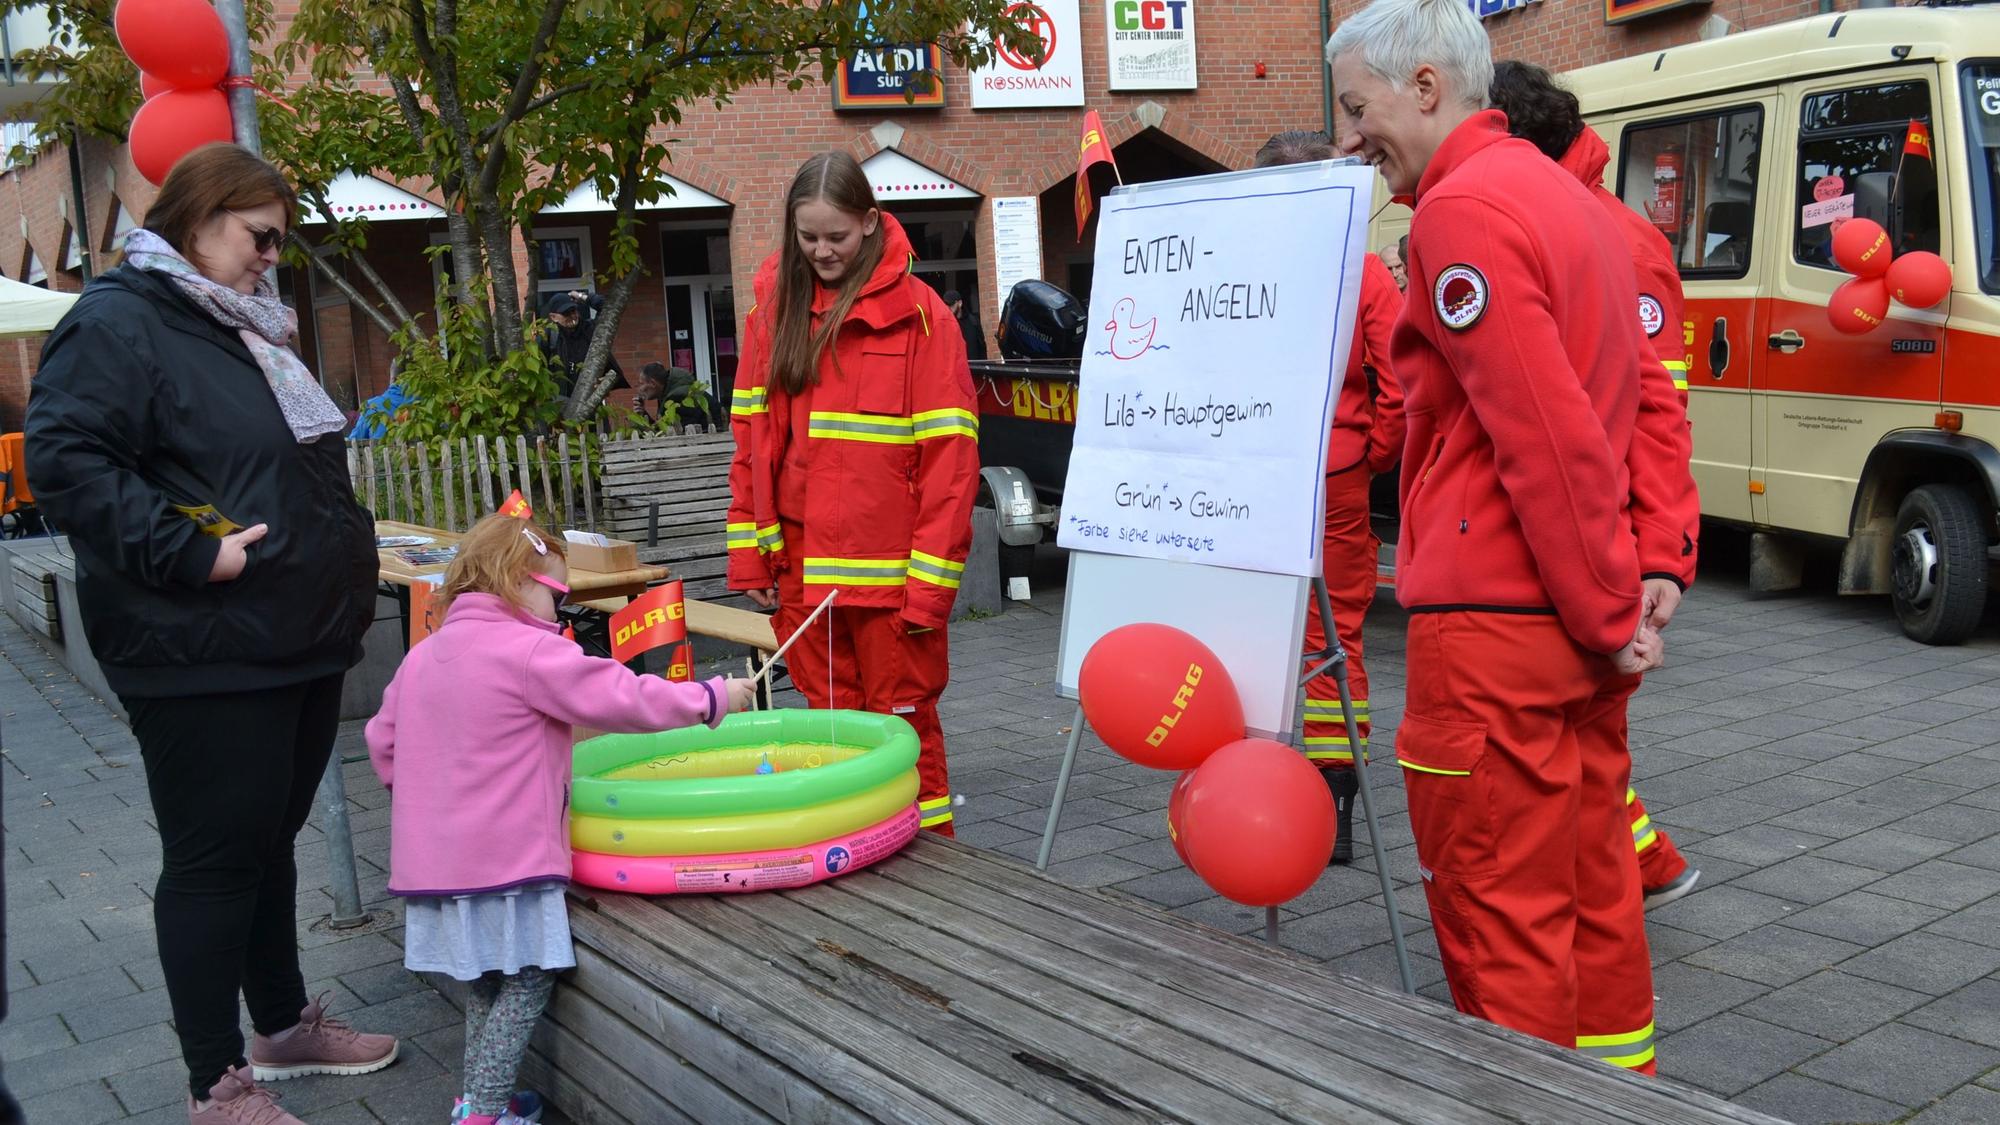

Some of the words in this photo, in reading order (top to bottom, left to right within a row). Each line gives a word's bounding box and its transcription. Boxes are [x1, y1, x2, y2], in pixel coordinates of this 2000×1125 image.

[1114, 1, 1187, 30] CCT
[1115, 31, 1128, 41] CITY
[1130, 31, 1151, 41] CENTER
[984, 76, 1072, 90] ROSSMANN
[1181, 283, 1277, 322] ANGELN
[1016, 321, 1053, 344] TOHATSU
[1012, 380, 1079, 422] DLR
[1164, 392, 1272, 437] Hauptgewinn
[1190, 491, 1249, 519] Gewinn
[1119, 527, 1149, 542] siehe
[615, 602, 684, 646] DLRG
[1145, 663, 1203, 747] DLRG
